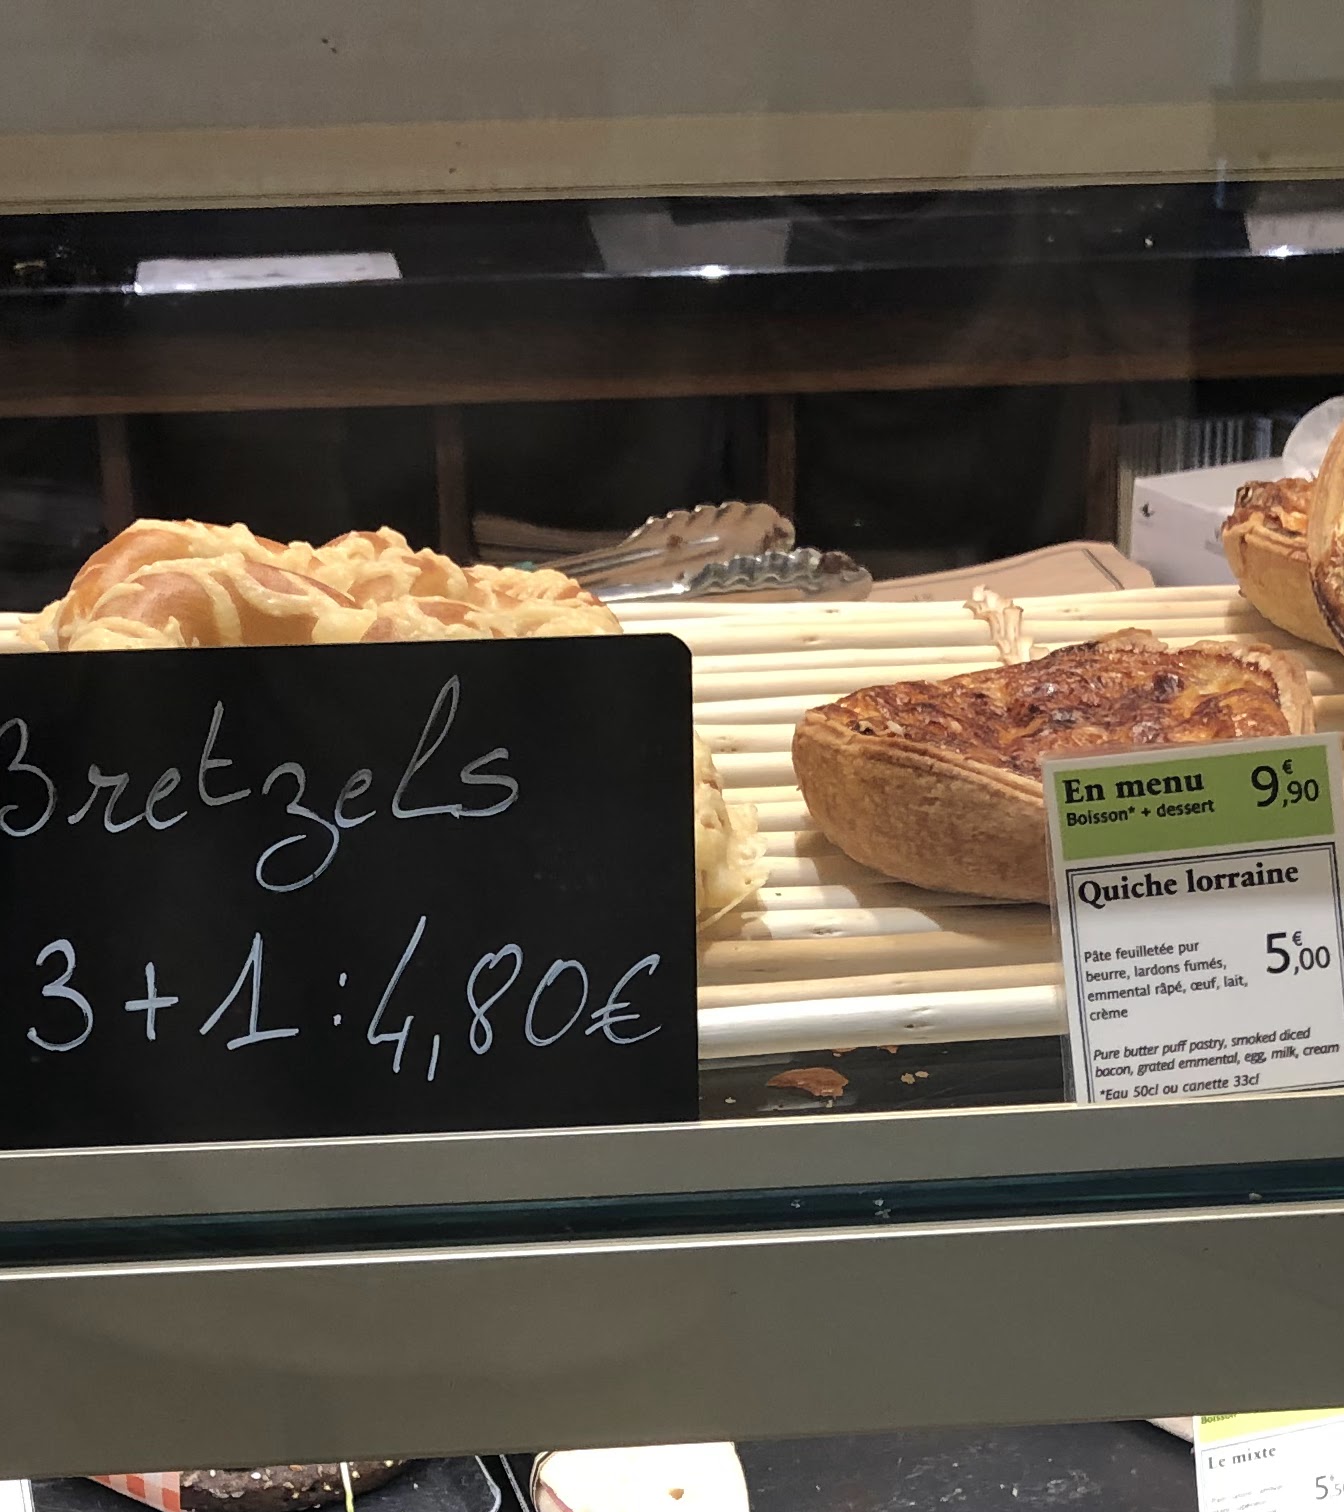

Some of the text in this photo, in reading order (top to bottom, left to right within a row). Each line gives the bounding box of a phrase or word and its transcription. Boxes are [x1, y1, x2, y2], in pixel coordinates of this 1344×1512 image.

[1062, 779, 1105, 804] En
[1115, 771, 1205, 797] menu
[1141, 807, 1152, 818] +
[1157, 799, 1215, 817] dessert
[1078, 862, 1299, 909] Quiche lorraine
[1084, 941, 1199, 962] Pâte feuilletée pur
[1085, 957, 1227, 982] beurre, lardons fumés,
[1087, 984, 1150, 1002] emmental
[1155, 980, 1186, 998] râpé,
[1224, 974, 1248, 989] lait,
[1089, 1007, 1128, 1021] crème
[1094, 1028, 1310, 1061] Pure butter puff pastry, smoked diced
[1133, 1084, 1158, 1098] 50cl
[1163, 1083, 1178, 1095] ou
[1182, 1077, 1229, 1093] canette
[1234, 1074, 1259, 1088] 33cl
[1208, 1448, 1276, 1469] Le mixte
